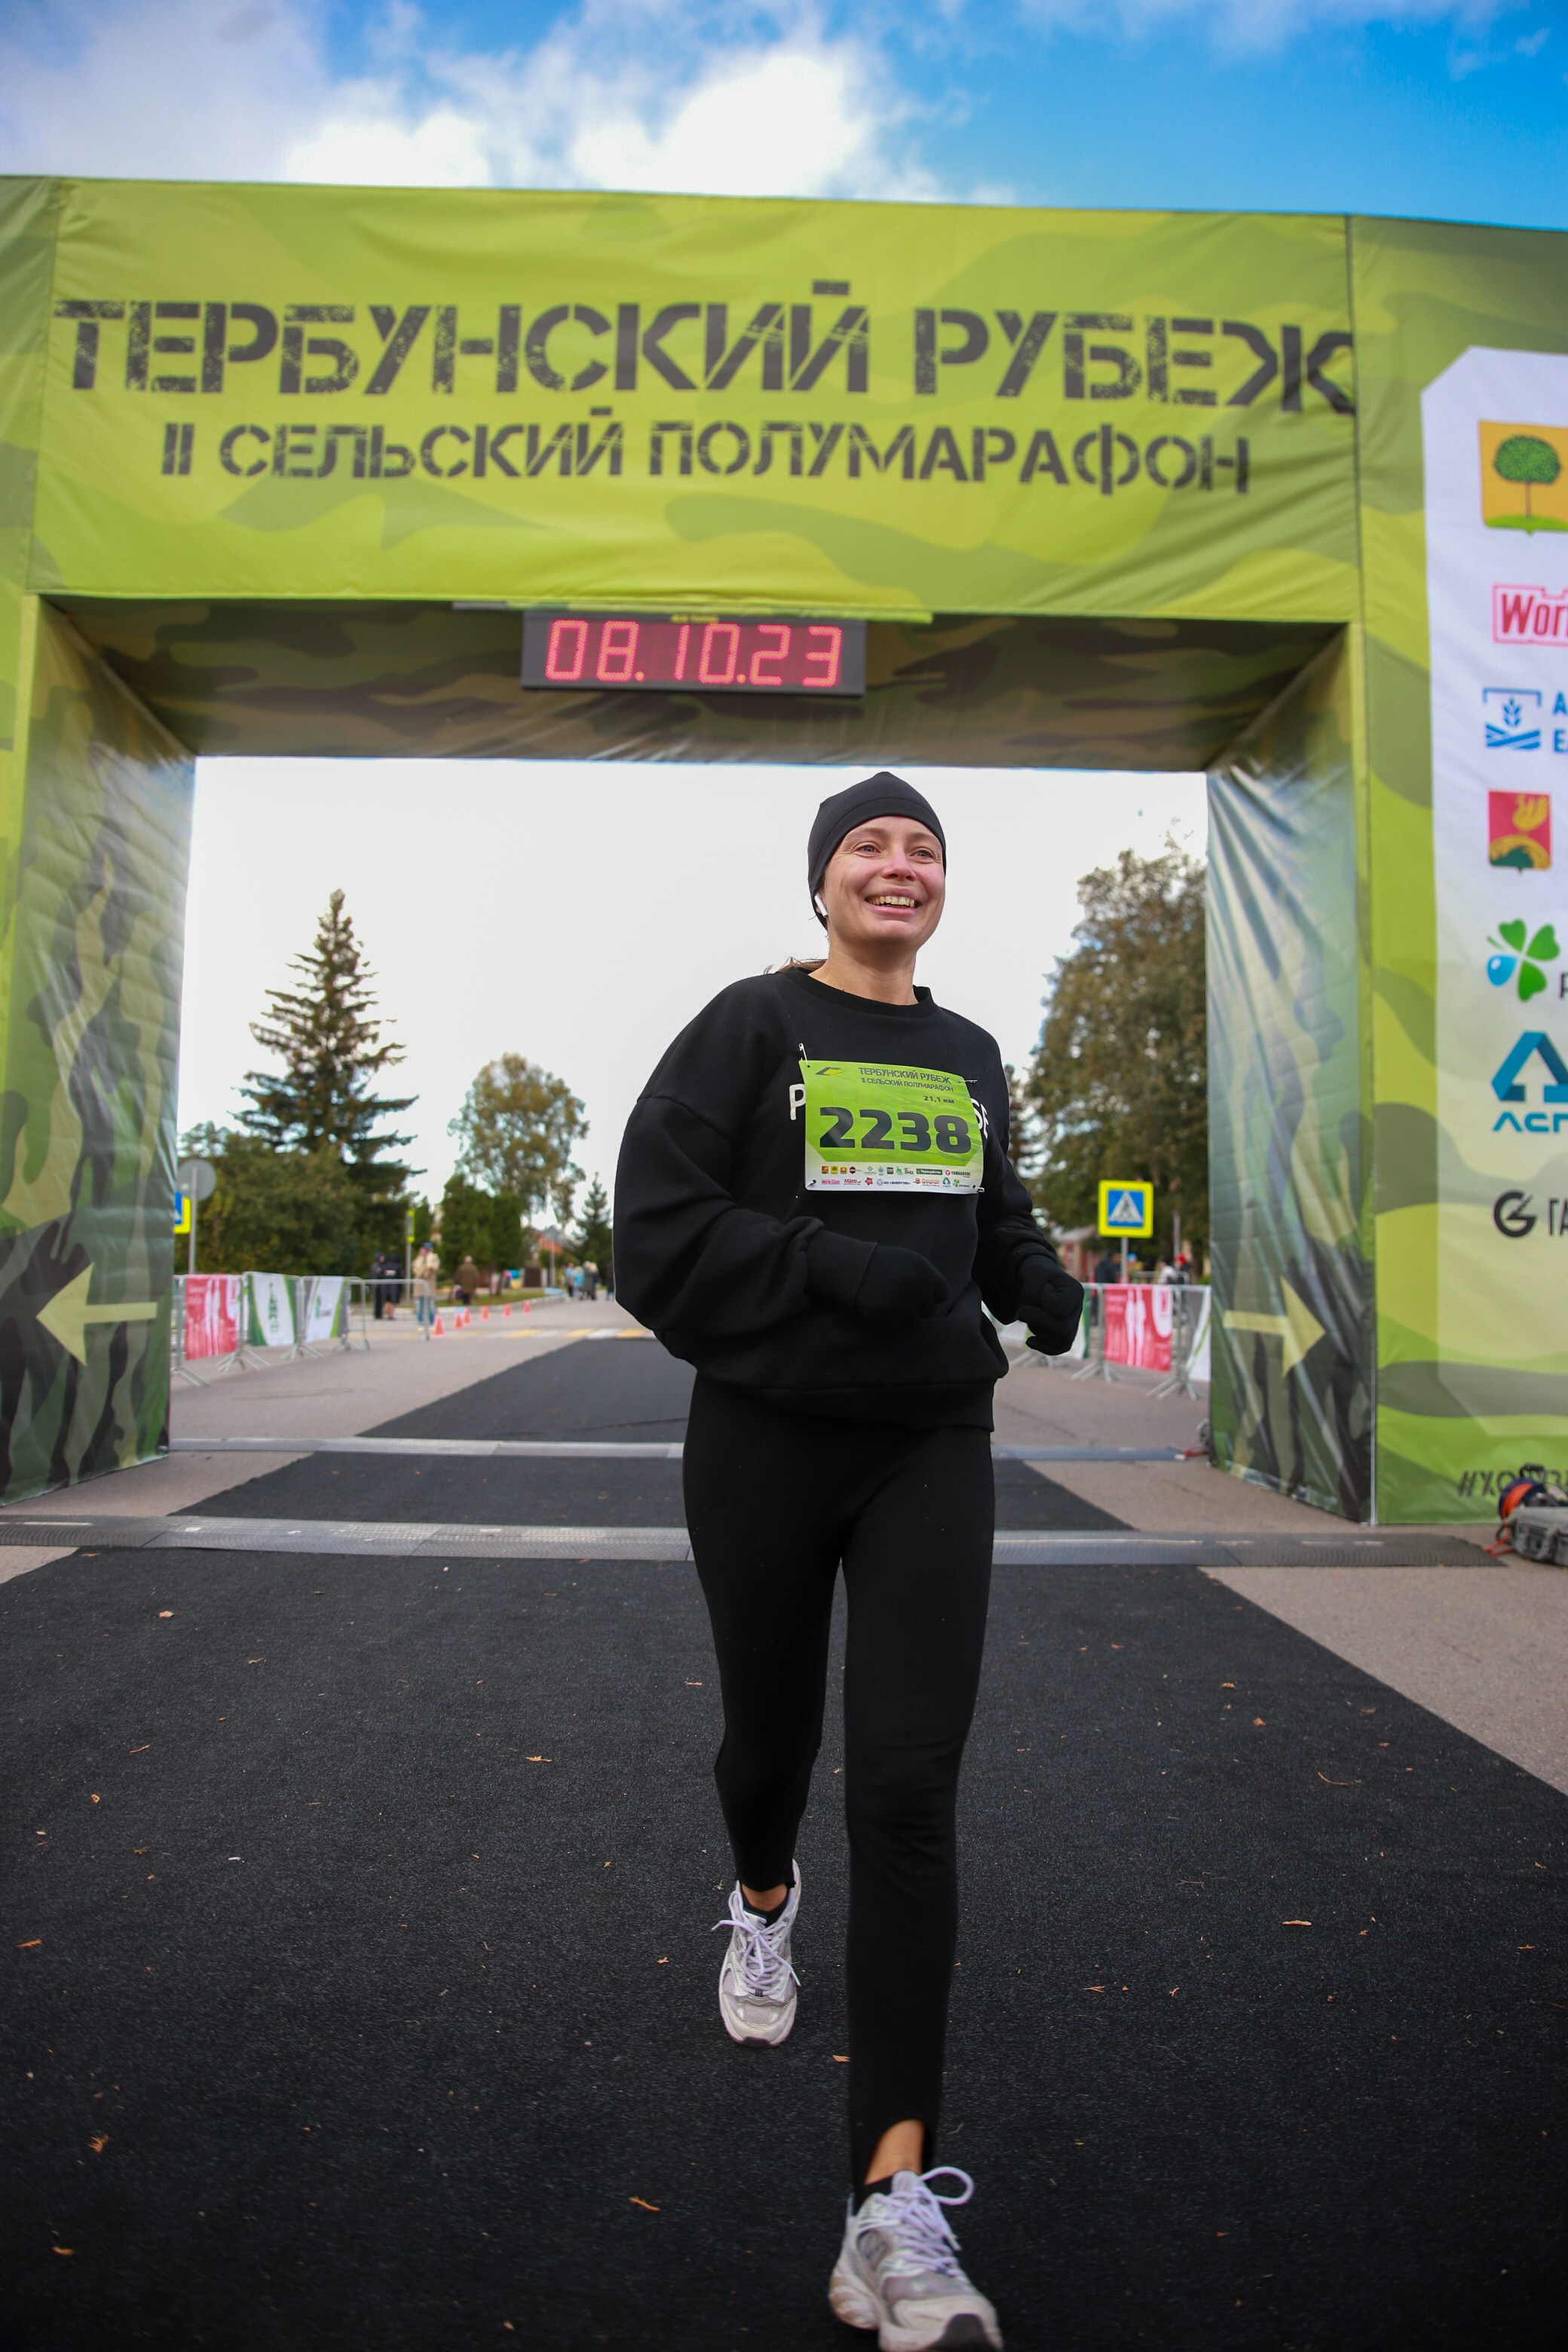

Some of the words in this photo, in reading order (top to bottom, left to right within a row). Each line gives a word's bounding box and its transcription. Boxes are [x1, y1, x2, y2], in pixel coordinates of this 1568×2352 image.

[53, 281, 870, 394] ТЕРБУНСКИЙ
[914, 308, 1355, 416] РУБЕЖ
[219, 406, 623, 478] СЕЛЬСКИЙ
[649, 421, 1250, 495] ПОЛУМАРАФОН
[1502, 593, 1568, 637] Wor
[547, 620, 843, 686] 08.10.23
[859, 1067, 918, 1080] ТЕРБУНСКИЙ
[920, 1072, 951, 1085] РУБЕЖ
[867, 1077, 902, 1086] СЕЛЬСКИЙ
[904, 1080, 954, 1092] ПОЛУМАРАФОН
[819, 1106, 972, 1154] 2238
